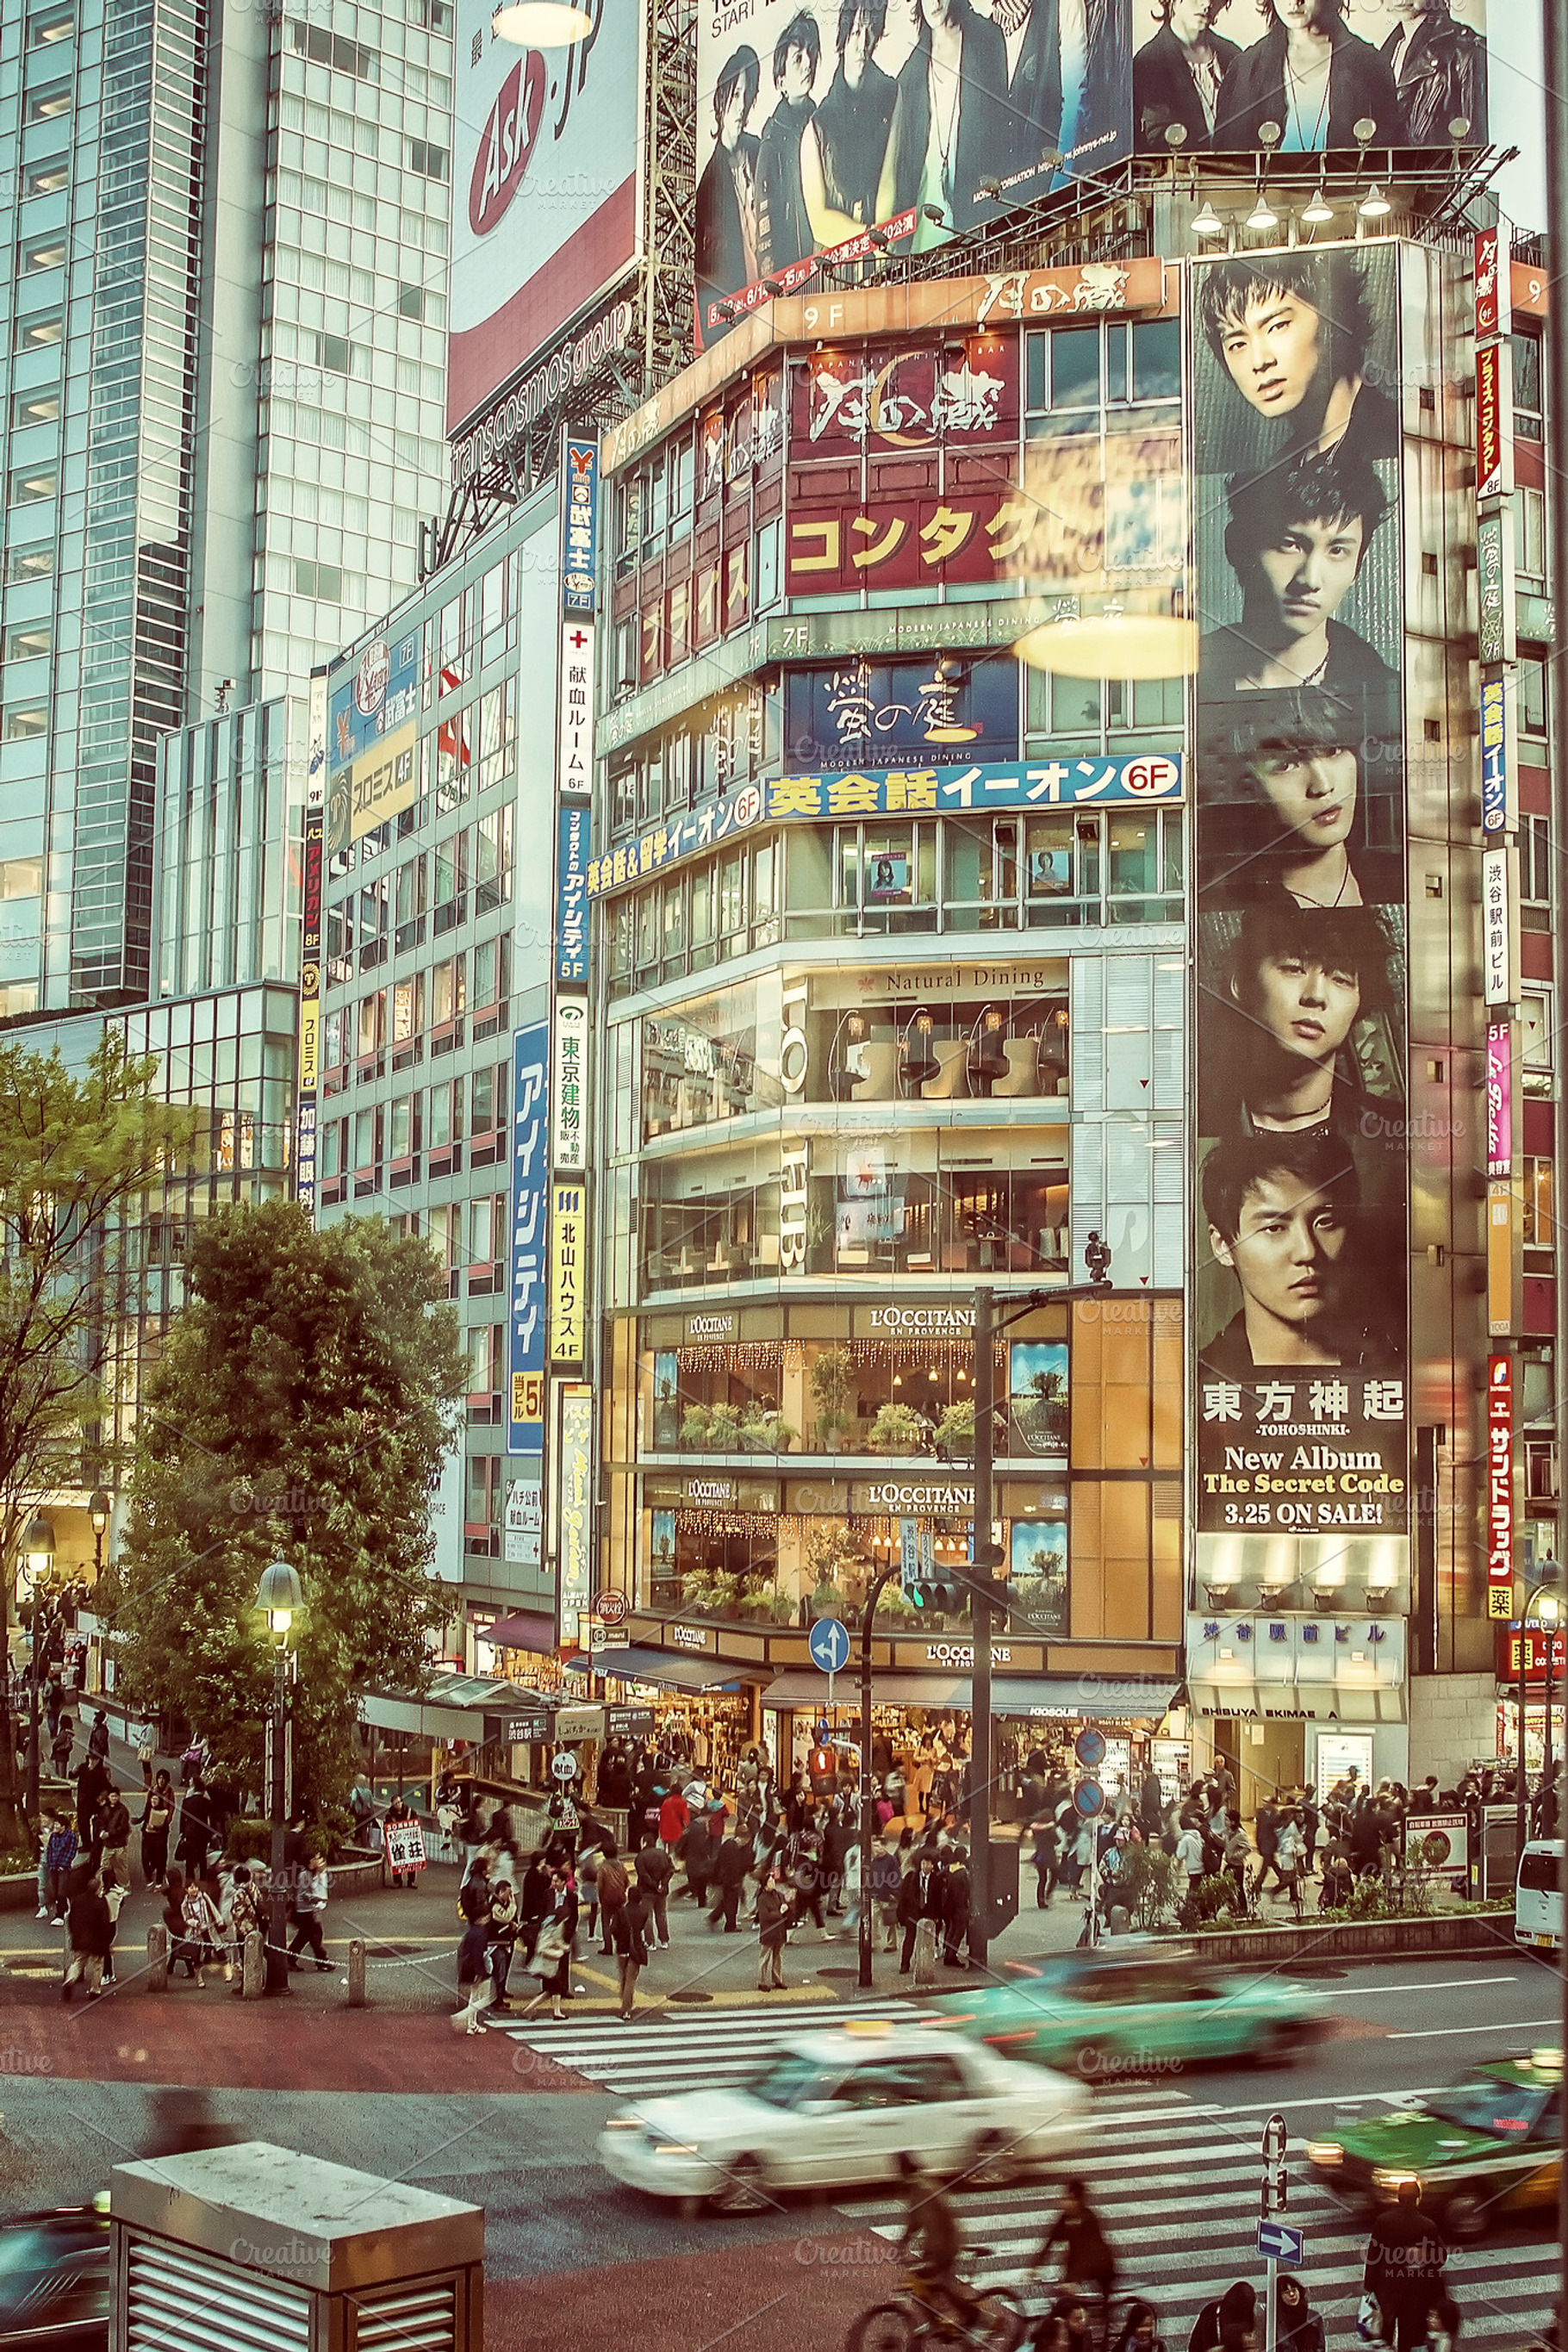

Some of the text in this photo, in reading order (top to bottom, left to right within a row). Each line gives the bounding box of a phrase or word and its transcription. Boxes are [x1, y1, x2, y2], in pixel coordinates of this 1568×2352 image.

[711, 0, 755, 39] START
[478, 49, 535, 223] ASK
[977, 345, 1005, 355] BAR
[450, 301, 633, 490] transcosmos group
[1487, 479, 1500, 494] 8F
[569, 504, 593, 569] 武富士
[781, 626, 808, 648] 7F
[888, 615, 1041, 635] MODERN JAPANESE DINING
[401, 640, 414, 664] 7F
[749, 636, 761, 659] 7F
[385, 681, 417, 729] 武富士
[568, 665, 587, 770] 献血ルーム
[1483, 681, 1505, 811] 英会話イーオン
[820, 752, 972, 768] MODERN JAPANESE DINING
[353, 752, 412, 817] プロミス 4F
[568, 778, 585, 790] 6F
[768, 762, 1170, 816] 英会話イーオン 6F
[1487, 812, 1502, 828] 6F
[587, 792, 756, 896] 英会話&留学イーオン 6F
[307, 846, 320, 928] アメリカン
[562, 873, 586, 961] アイシティ
[1488, 864, 1505, 991] 渋谷駅前ビル
[304, 933, 320, 947] 8F
[561, 961, 584, 979] 5F
[887, 968, 1044, 991] Natural Dining
[1488, 1024, 1509, 1042] 5F
[303, 1018, 315, 1073] プロミス
[561, 1036, 581, 1130] 東京建物
[1488, 1048, 1503, 1154] La Fiesta
[570, 1130, 581, 1165] 不動産
[514, 1062, 543, 1354] アイシティ
[560, 1223, 576, 1336] 北山ハウス
[690, 1315, 732, 1334] L'OCCITANE
[908, 1327, 961, 1335] PROVENCE
[554, 1342, 579, 1358] 4F
[513, 1376, 525, 1420] 当ビル
[1202, 1379, 1404, 1422] 東方神起
[1224, 1445, 1383, 1470] New Album
[688, 1478, 731, 1499] L'OCCITANE
[1204, 1473, 1404, 1493] The Secret Code
[513, 1490, 538, 1507] ハチ公前
[906, 1504, 961, 1513] PROVENCE
[1490, 1427, 1511, 1577] サンドラッグ
[1224, 1503, 1383, 1525] 3.25 ON SALE!
[1491, 1590, 1509, 1615] 薬
[1204, 1621, 1387, 1642] 渋谷駅前ビル
[926, 1644, 1011, 1663] L'OCCINE
[1202, 1708, 1258, 1717] SHIBUYA
[1266, 1709, 1316, 1719] EKIMAE
